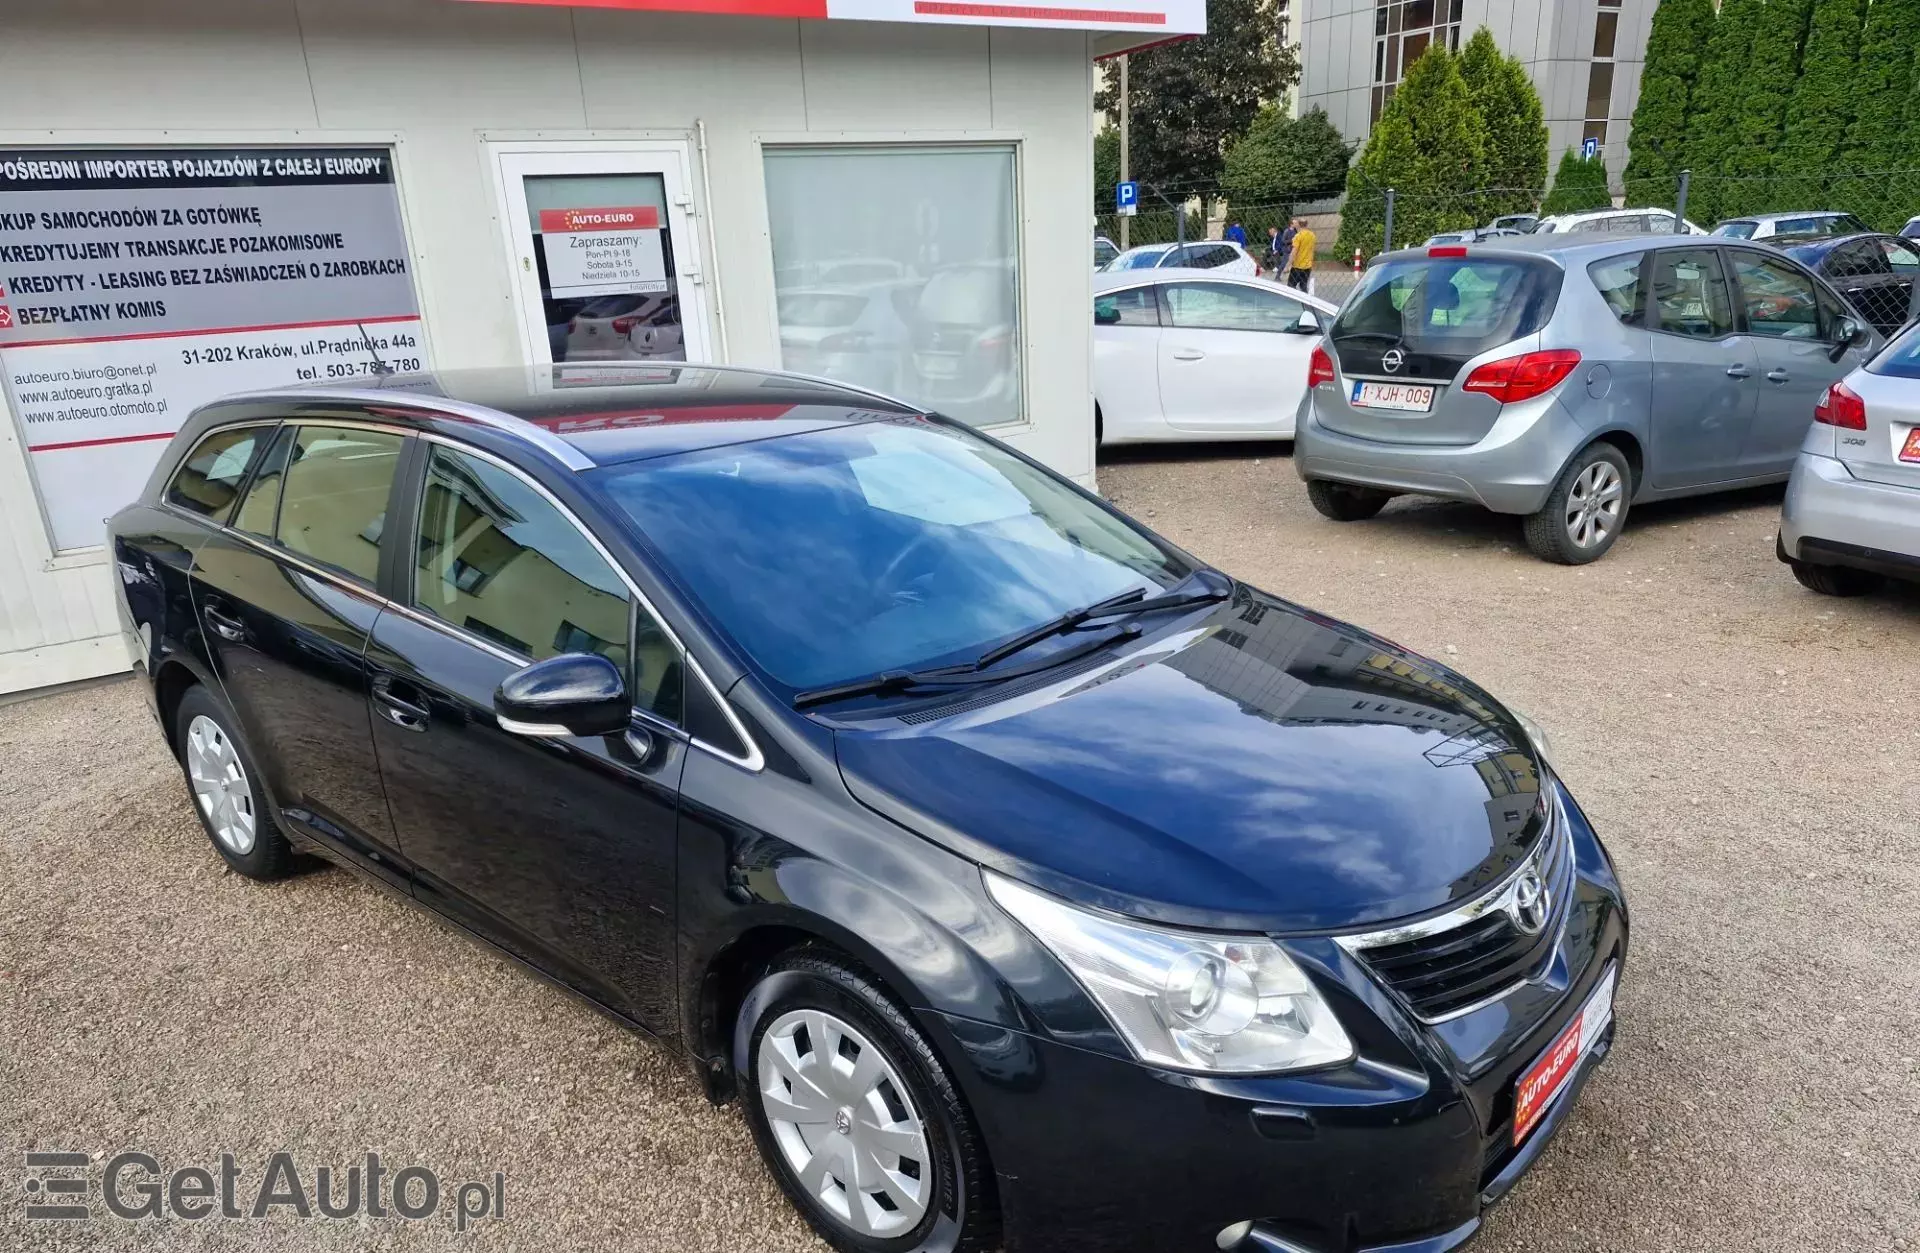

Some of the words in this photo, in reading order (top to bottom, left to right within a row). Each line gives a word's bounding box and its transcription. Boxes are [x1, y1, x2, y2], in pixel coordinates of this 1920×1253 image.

[83, 159, 171, 179] IMPORTER
[172, 154, 258, 178] POJAZDÓW
[260, 158, 273, 177] Z
[274, 157, 321, 176] CAŁEJ
[324, 157, 381, 175] EUROPY
[1121, 184, 1133, 204] P
[0, 212, 36, 231] KUP
[40, 205, 158, 230] SAMOCHODÓW
[161, 209, 184, 226] ZA
[186, 203, 262, 228] GOTÓWKĘ
[572, 213, 635, 225] AUTO-EURO
[0, 241, 120, 263] KREDYTUJEMY
[124, 238, 227, 258] TRANSAKCJE
[229, 233, 345, 254] POZAKOMISOWE
[569, 234, 643, 250] Zapraszamy:
[8, 273, 84, 294] KREDYTY
[98, 269, 168, 290] LEASING
[170, 268, 201, 286] BEZ
[202, 259, 307, 284] ZAŚWIADCZEŃ
[310, 262, 320, 278] O
[323, 258, 406, 278] ZAROBKACH
[586, 261, 614, 270] Sobota
[615, 258, 633, 268] 9-15
[619, 268, 640, 278] 10-15
[17, 303, 110, 325] BEZPŁATNY
[115, 300, 166, 319] KOMIS
[182, 346, 233, 365] 31-202
[236, 343, 298, 361] Kraków,
[301, 336, 388, 357] ul.Prądnicka
[391, 333, 416, 349] 44a
[14, 362, 157, 385] autoeuro.biuro@onet.pl
[296, 366, 322, 381] tel.
[19, 380, 153, 404] www.autoeuro.gratka.pl
[1363, 384, 1431, 405] 1-XJH-009
[25, 398, 168, 424] www.autoeuro.otomoto.pl
[1520, 1031, 1579, 1112] AUTO-EURO
